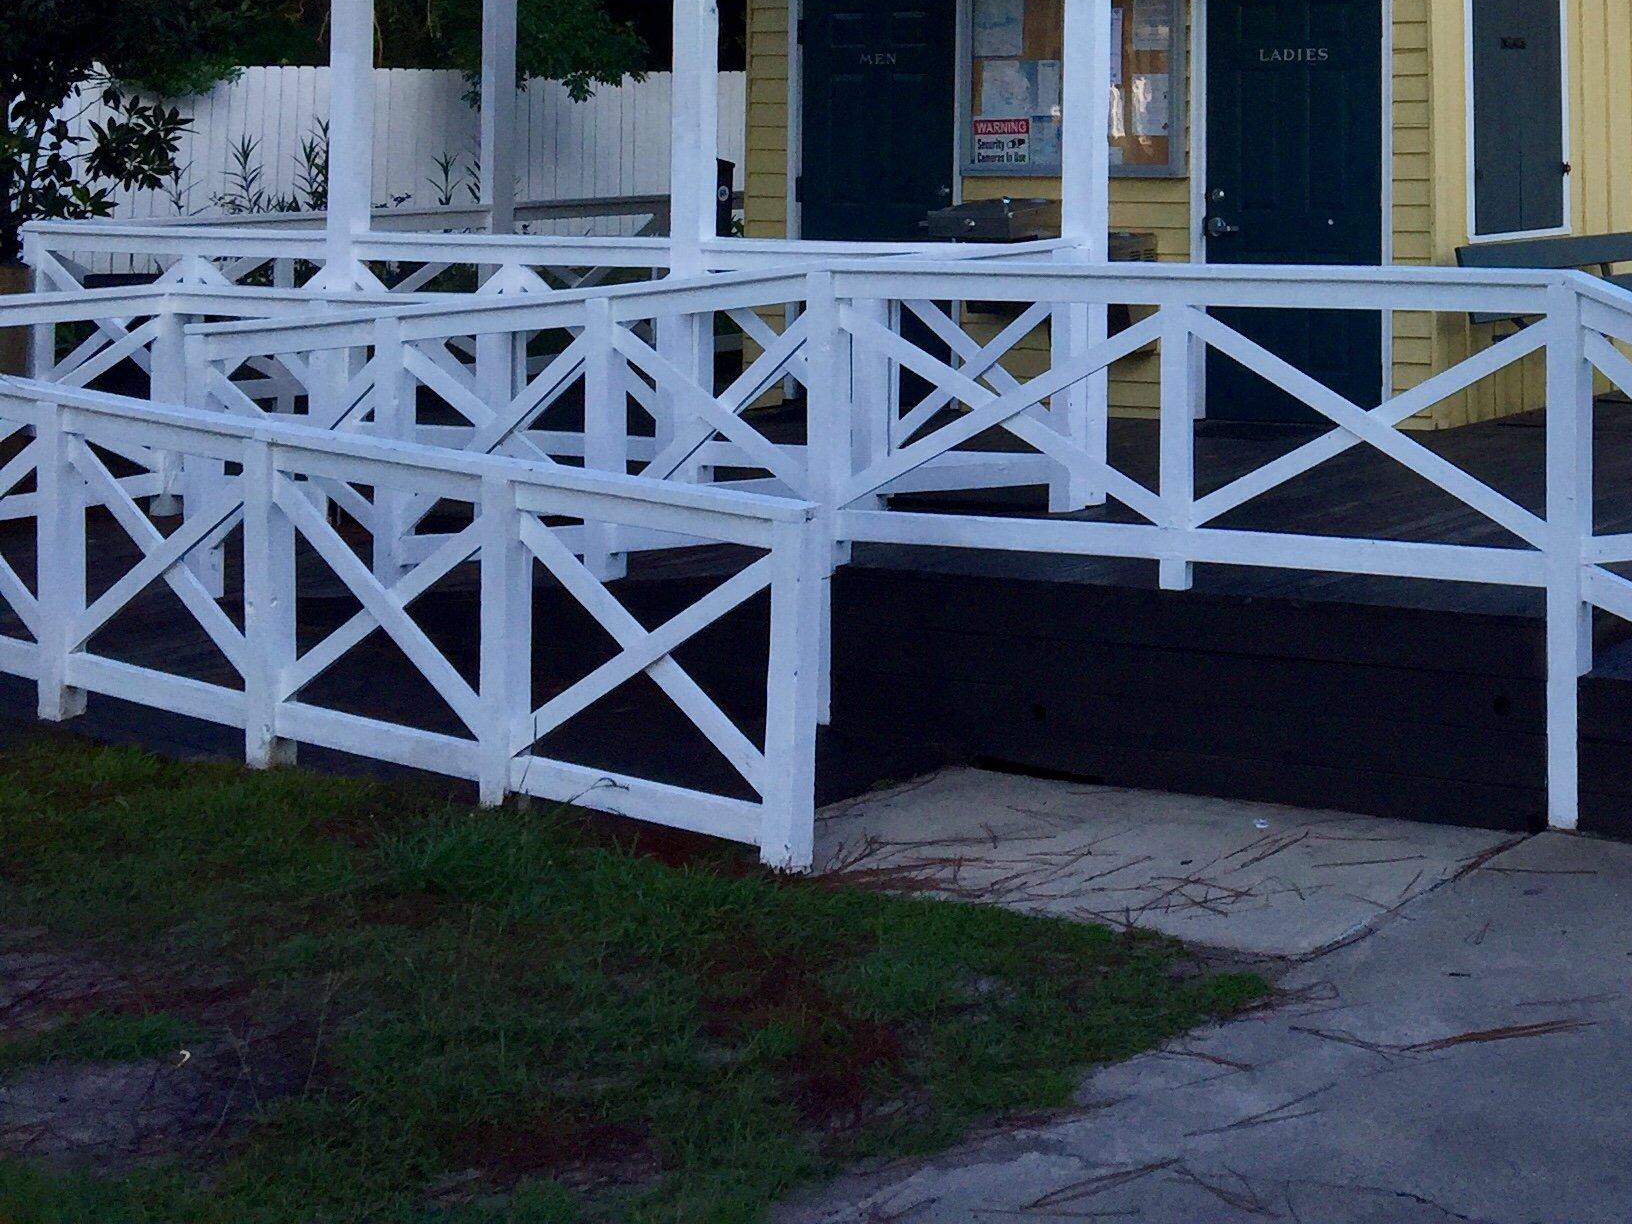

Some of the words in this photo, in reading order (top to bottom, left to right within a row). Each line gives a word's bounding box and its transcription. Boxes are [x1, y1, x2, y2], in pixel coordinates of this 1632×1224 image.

[858, 53, 896, 65] MEN
[1259, 47, 1329, 62] LADIES
[977, 120, 1027, 133] WARNING
[977, 138, 1004, 151] Security
